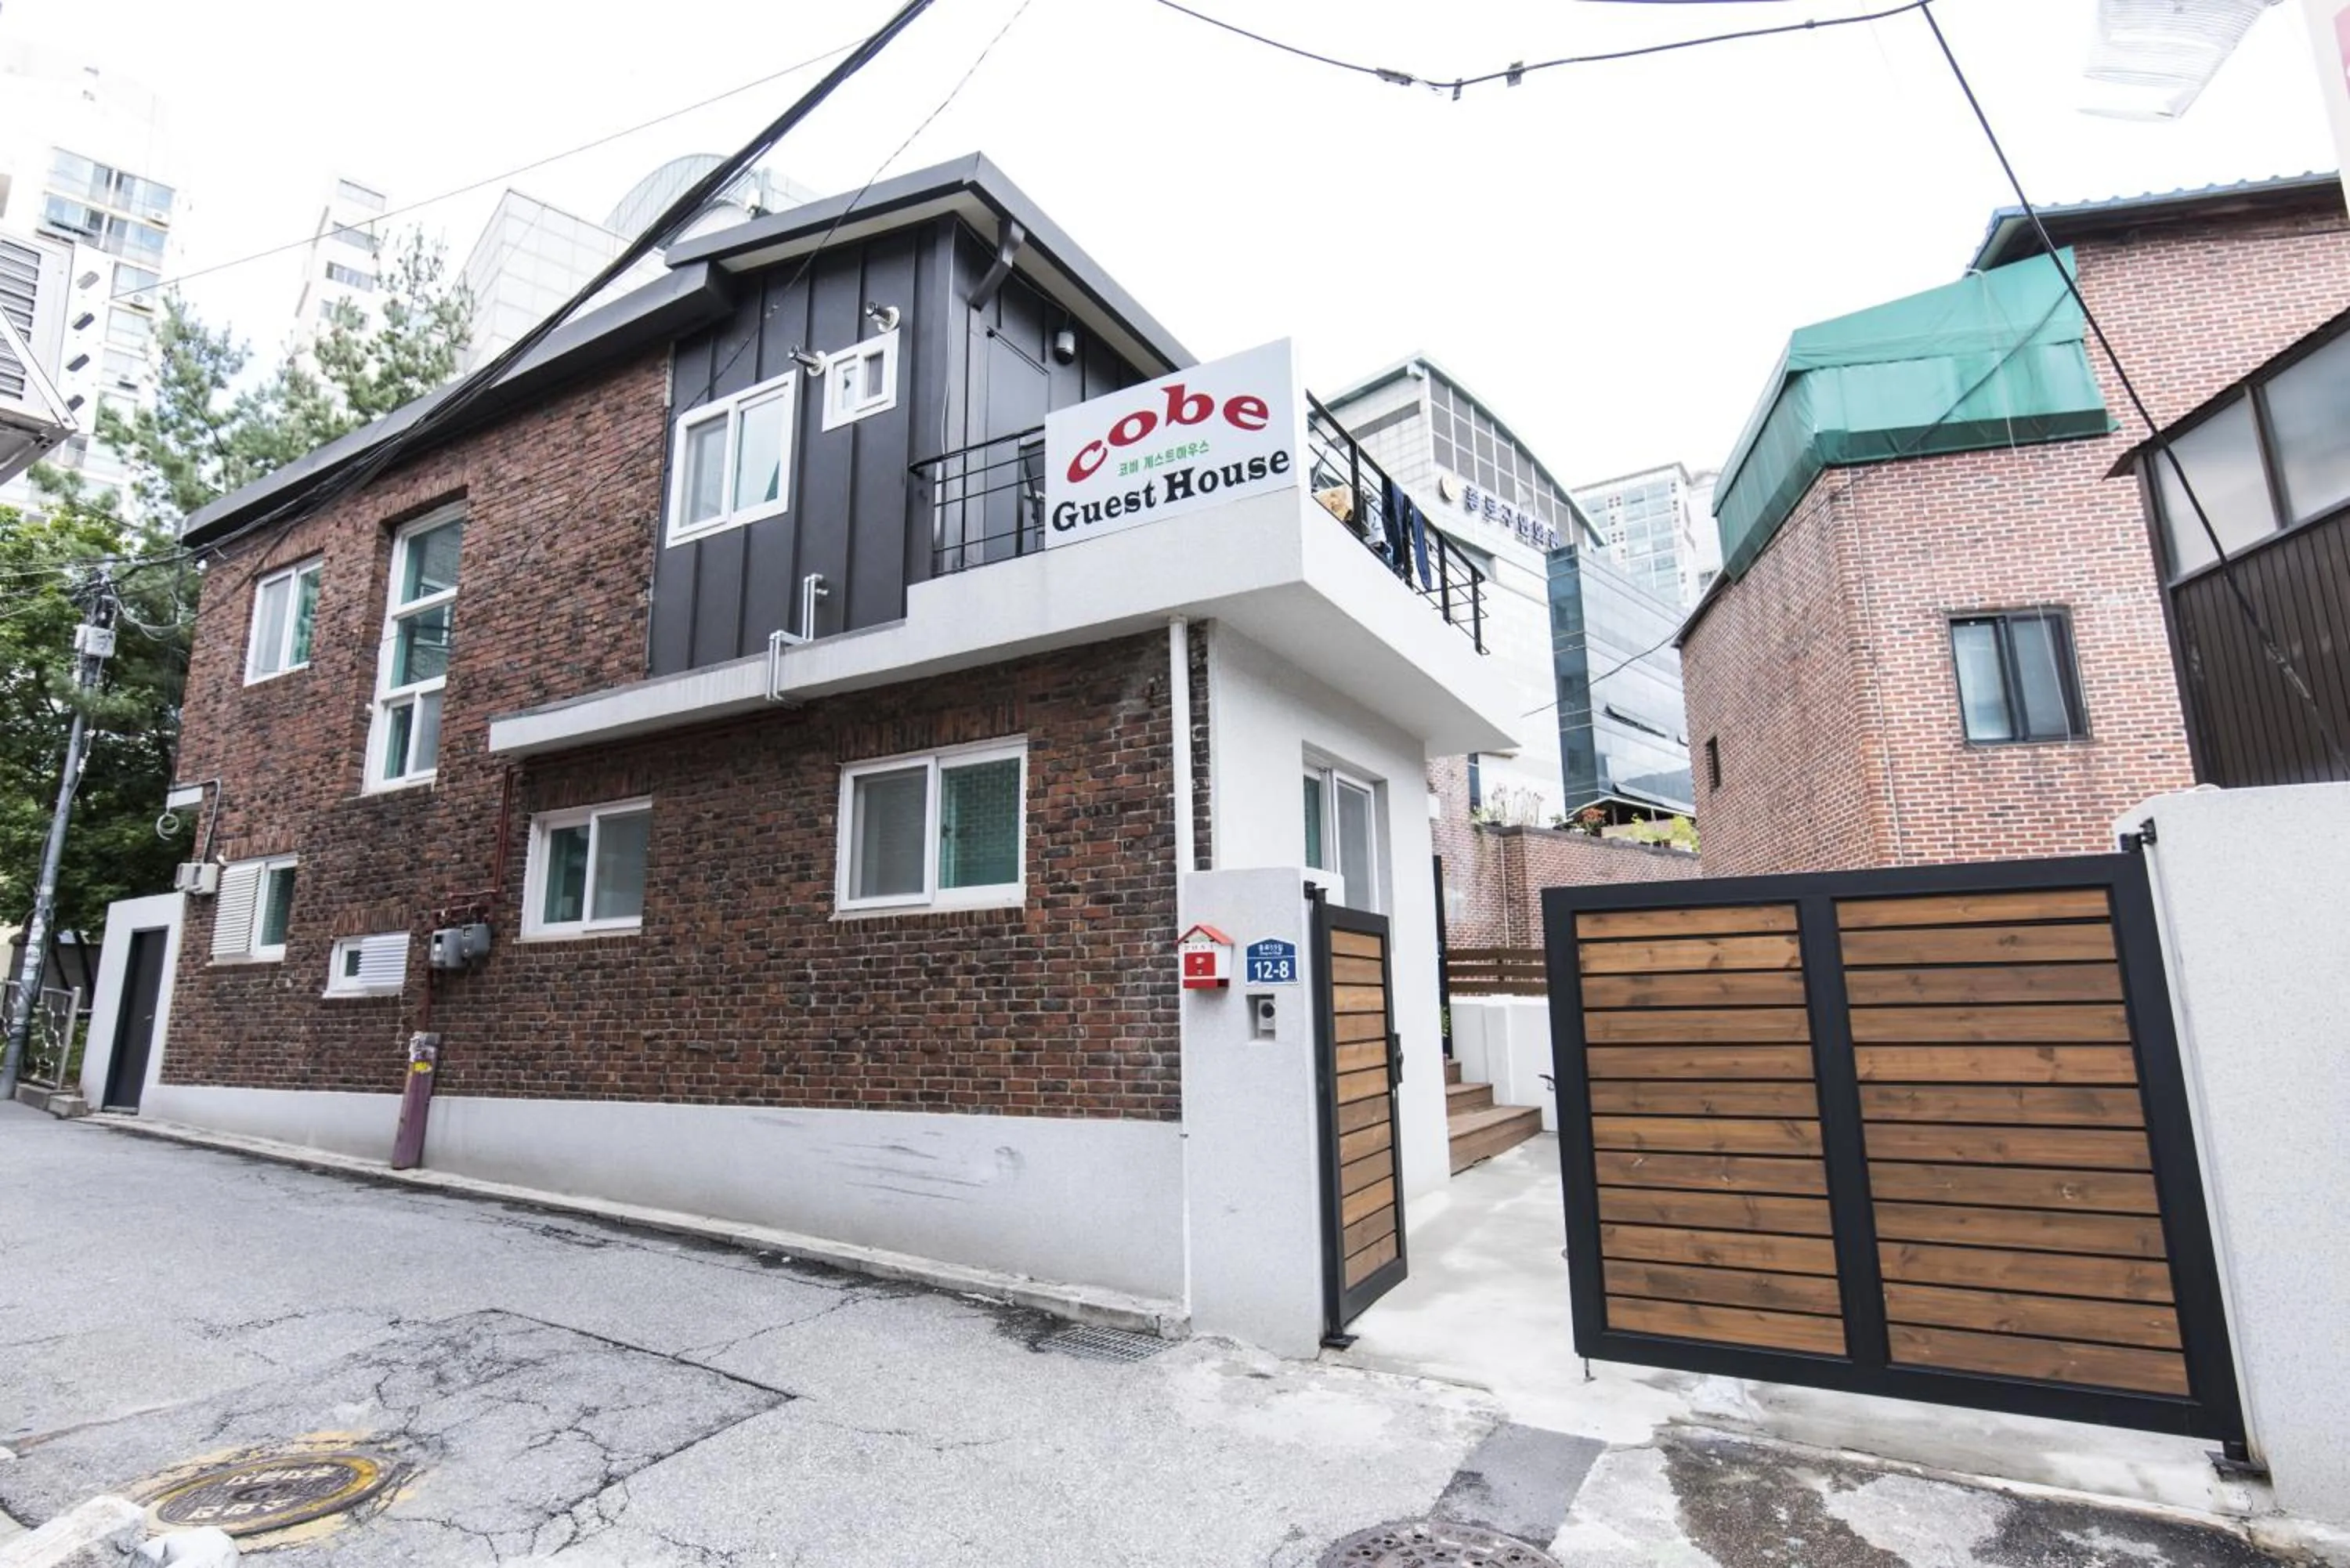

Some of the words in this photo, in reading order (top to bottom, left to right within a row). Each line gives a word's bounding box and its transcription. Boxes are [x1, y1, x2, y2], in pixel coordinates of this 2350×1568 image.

[1052, 477, 1157, 532] Guest
[1162, 449, 1290, 504] House
[1254, 960, 1289, 978] 12-8
